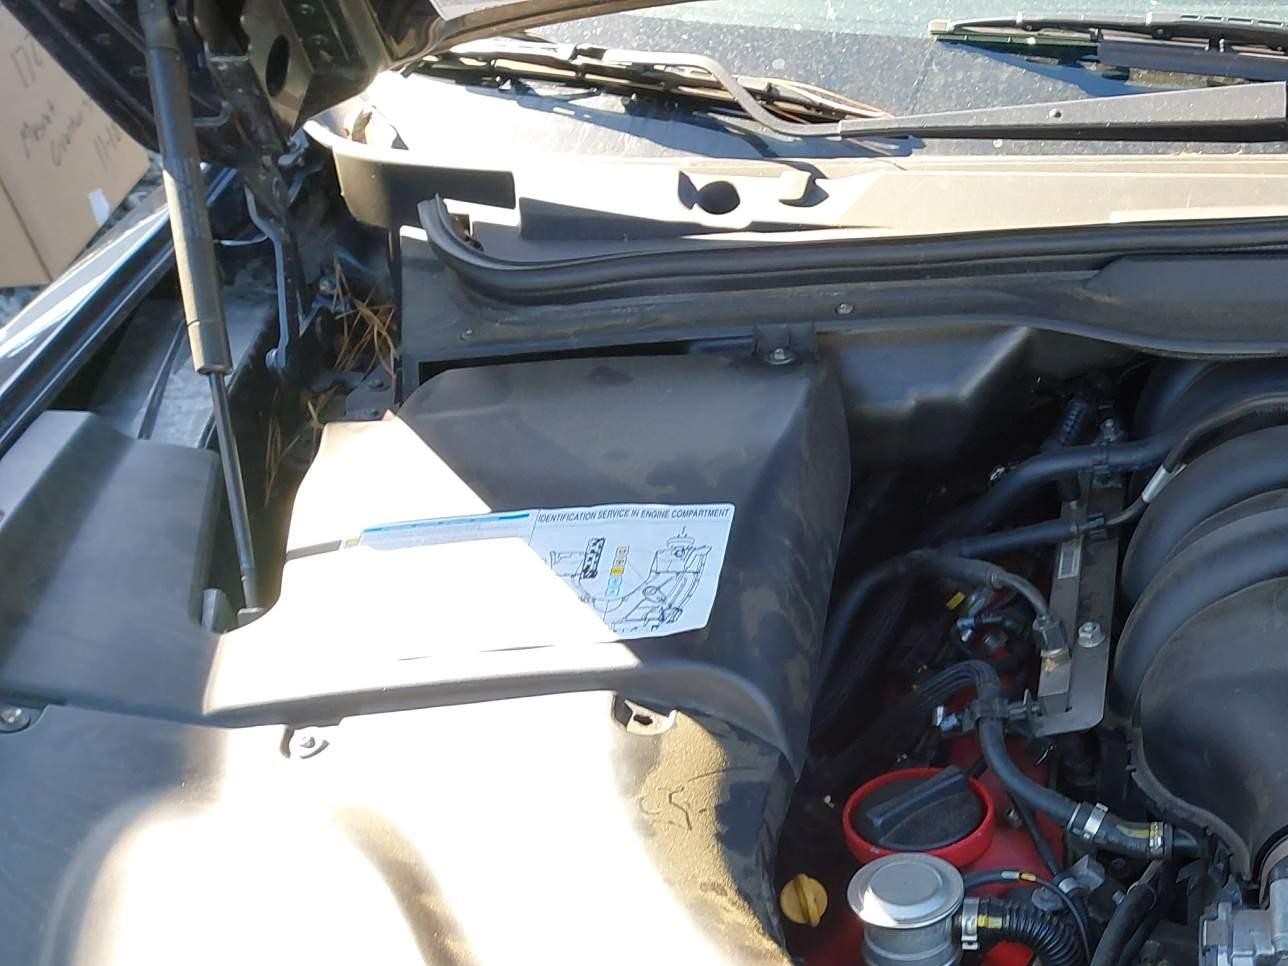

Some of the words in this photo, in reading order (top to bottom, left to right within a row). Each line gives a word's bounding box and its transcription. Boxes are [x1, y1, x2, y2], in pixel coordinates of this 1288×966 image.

[537, 512, 597, 523] IDENTIFICATION
[597, 509, 629, 520] SERVICE
[630, 509, 640, 519] IN
[641, 509, 668, 519] ENGINE
[671, 508, 730, 518] COMPARTMENT
